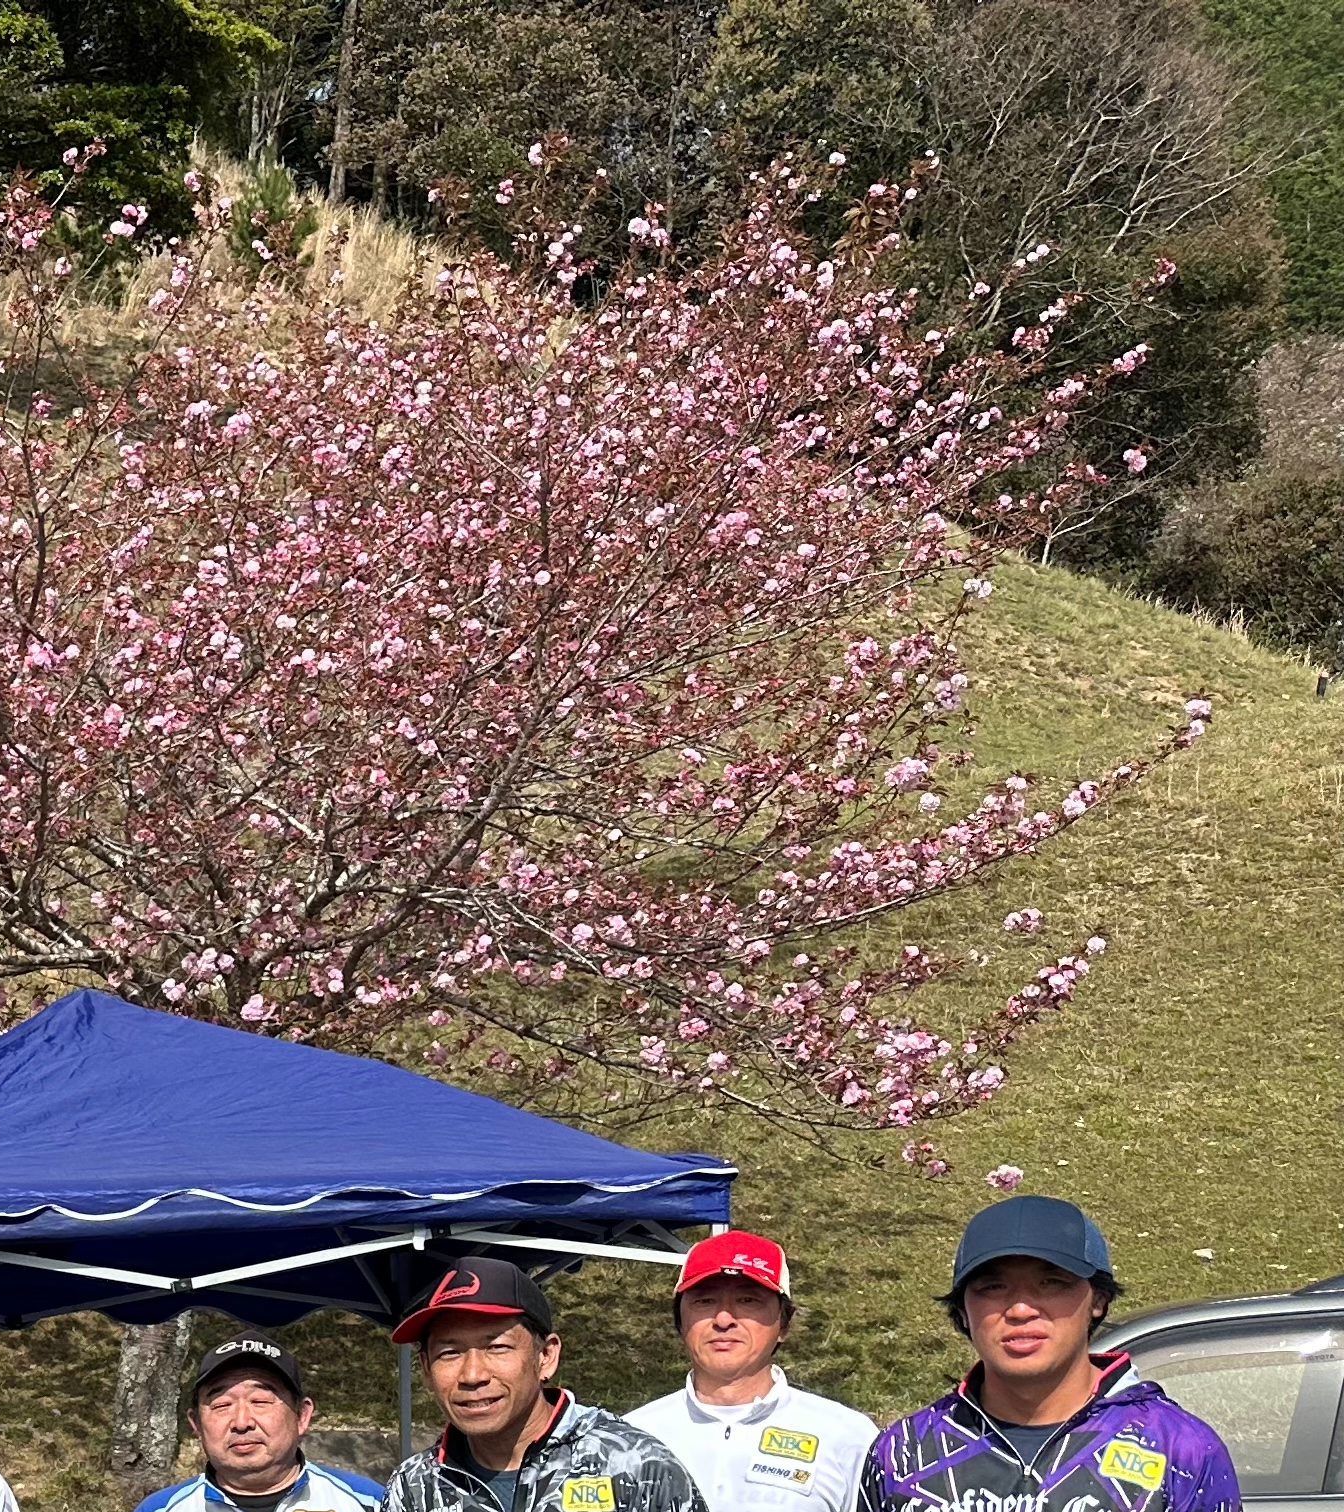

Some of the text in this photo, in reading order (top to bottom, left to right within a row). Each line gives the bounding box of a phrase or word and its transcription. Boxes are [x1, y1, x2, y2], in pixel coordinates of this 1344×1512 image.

[766, 1432, 812, 1454] NBC
[752, 1463, 791, 1478] FISHING
[1108, 1449, 1159, 1480] NBC
[569, 1484, 609, 1505] NBC
